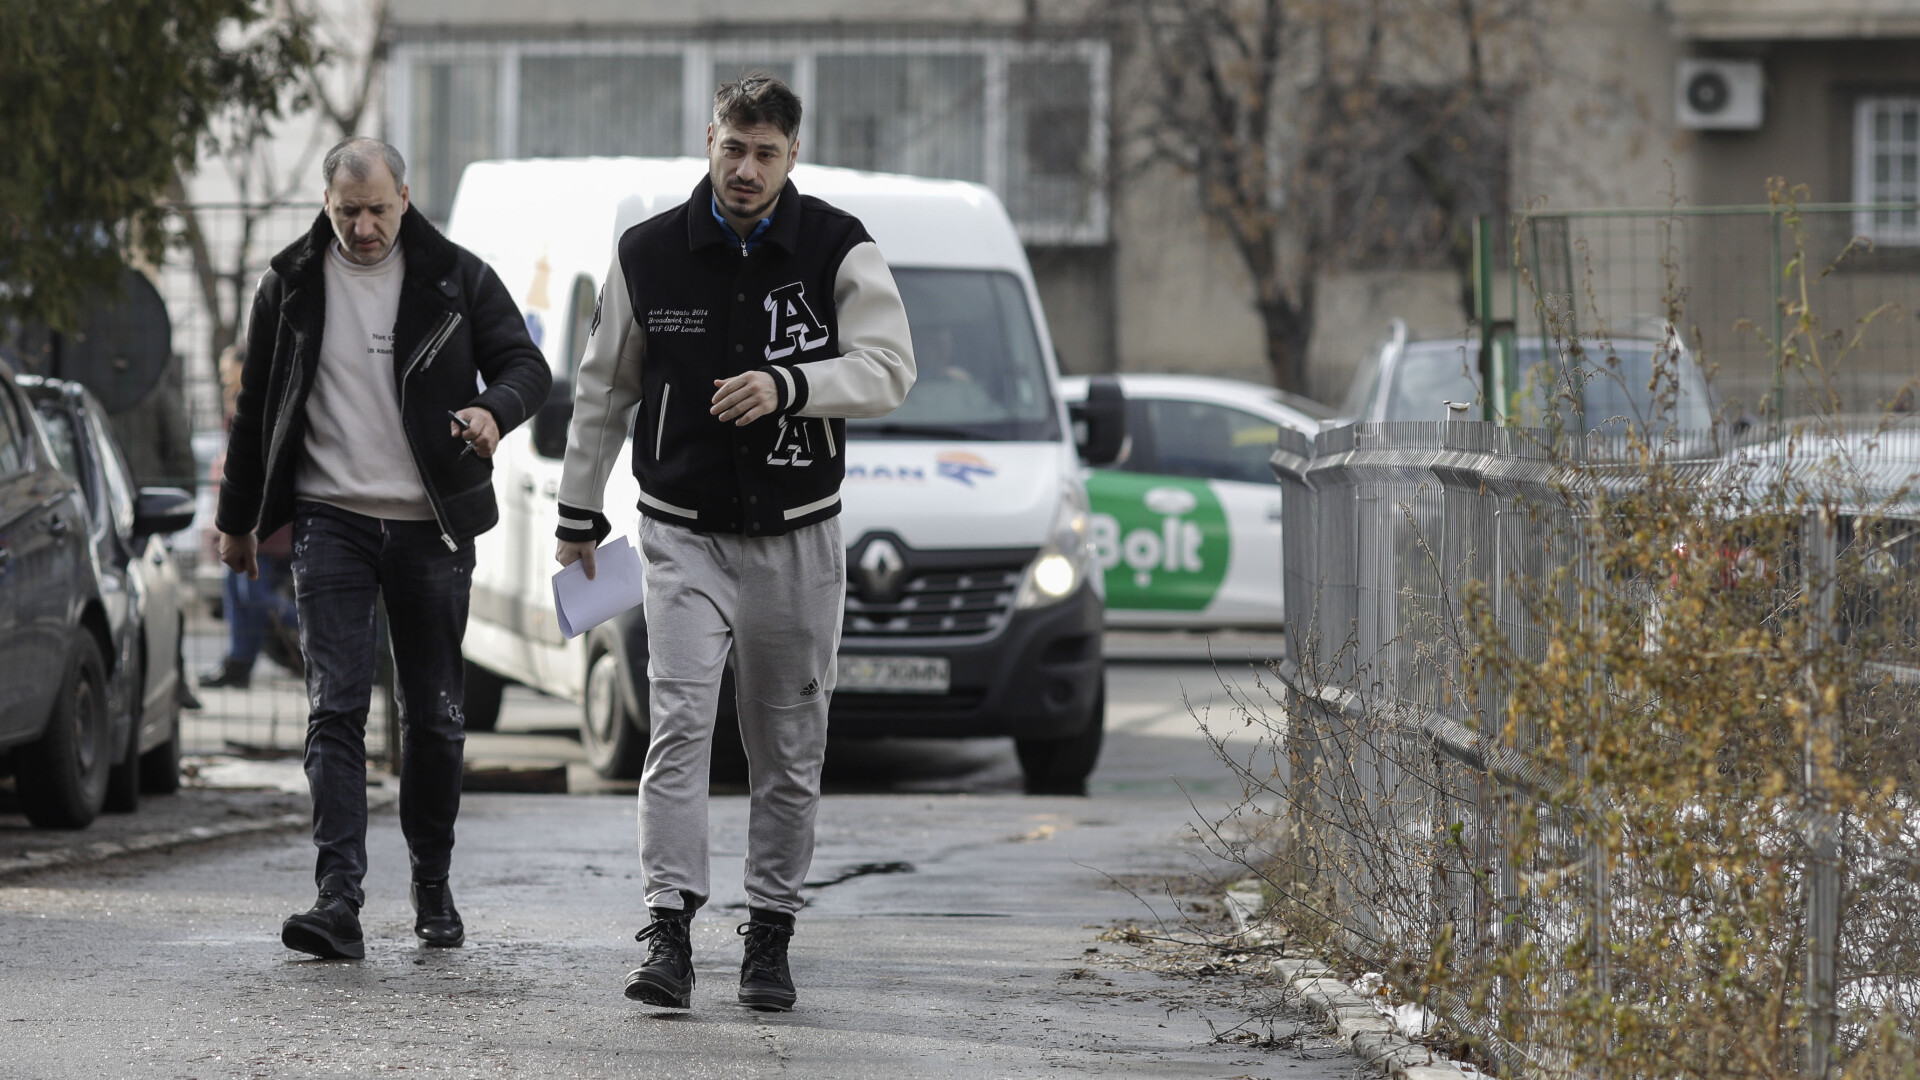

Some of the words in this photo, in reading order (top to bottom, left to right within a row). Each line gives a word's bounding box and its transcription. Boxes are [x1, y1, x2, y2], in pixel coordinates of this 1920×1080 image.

[680, 325, 706, 333] London
[684, 317, 704, 325] Street
[763, 281, 829, 361] A
[1089, 511, 1204, 588] Bolt
